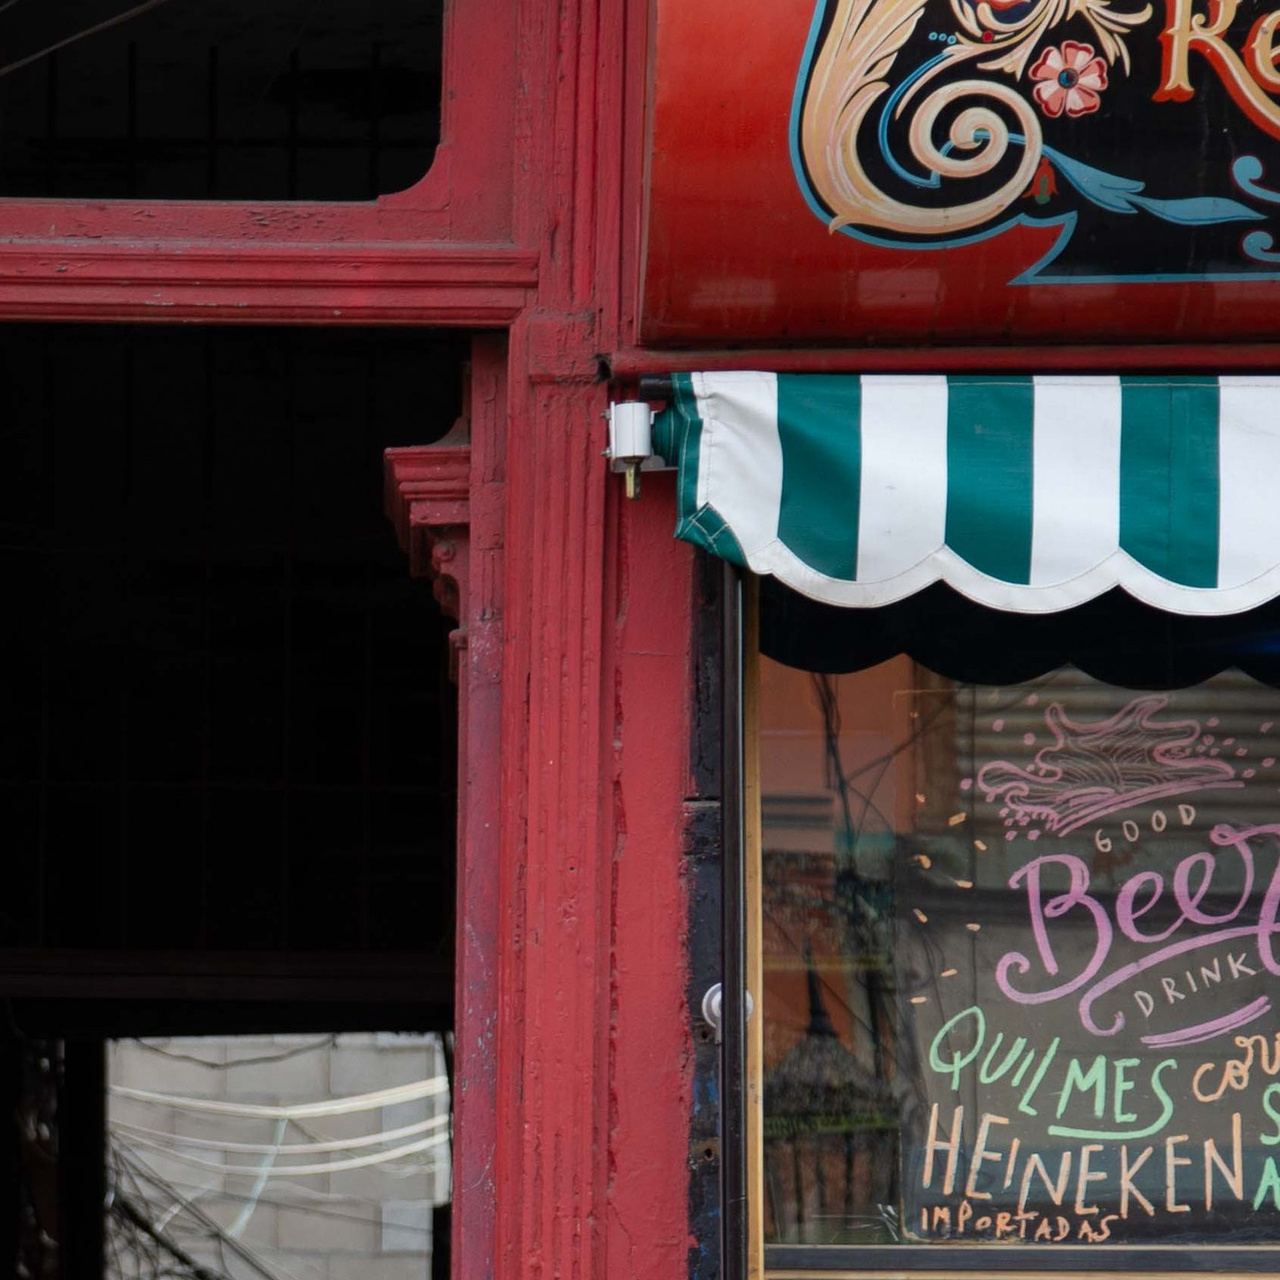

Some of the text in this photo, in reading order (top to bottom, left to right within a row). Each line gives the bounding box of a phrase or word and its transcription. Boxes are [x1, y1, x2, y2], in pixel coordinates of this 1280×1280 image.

[1094, 804, 1196, 852] GOOD
[1133, 952, 1257, 1017] DRINK
[929, 1006, 1178, 1139] QUILMES
[922, 1103, 1244, 1219] HEINEKEN
[921, 1200, 1120, 1243] IMPORTADAS
